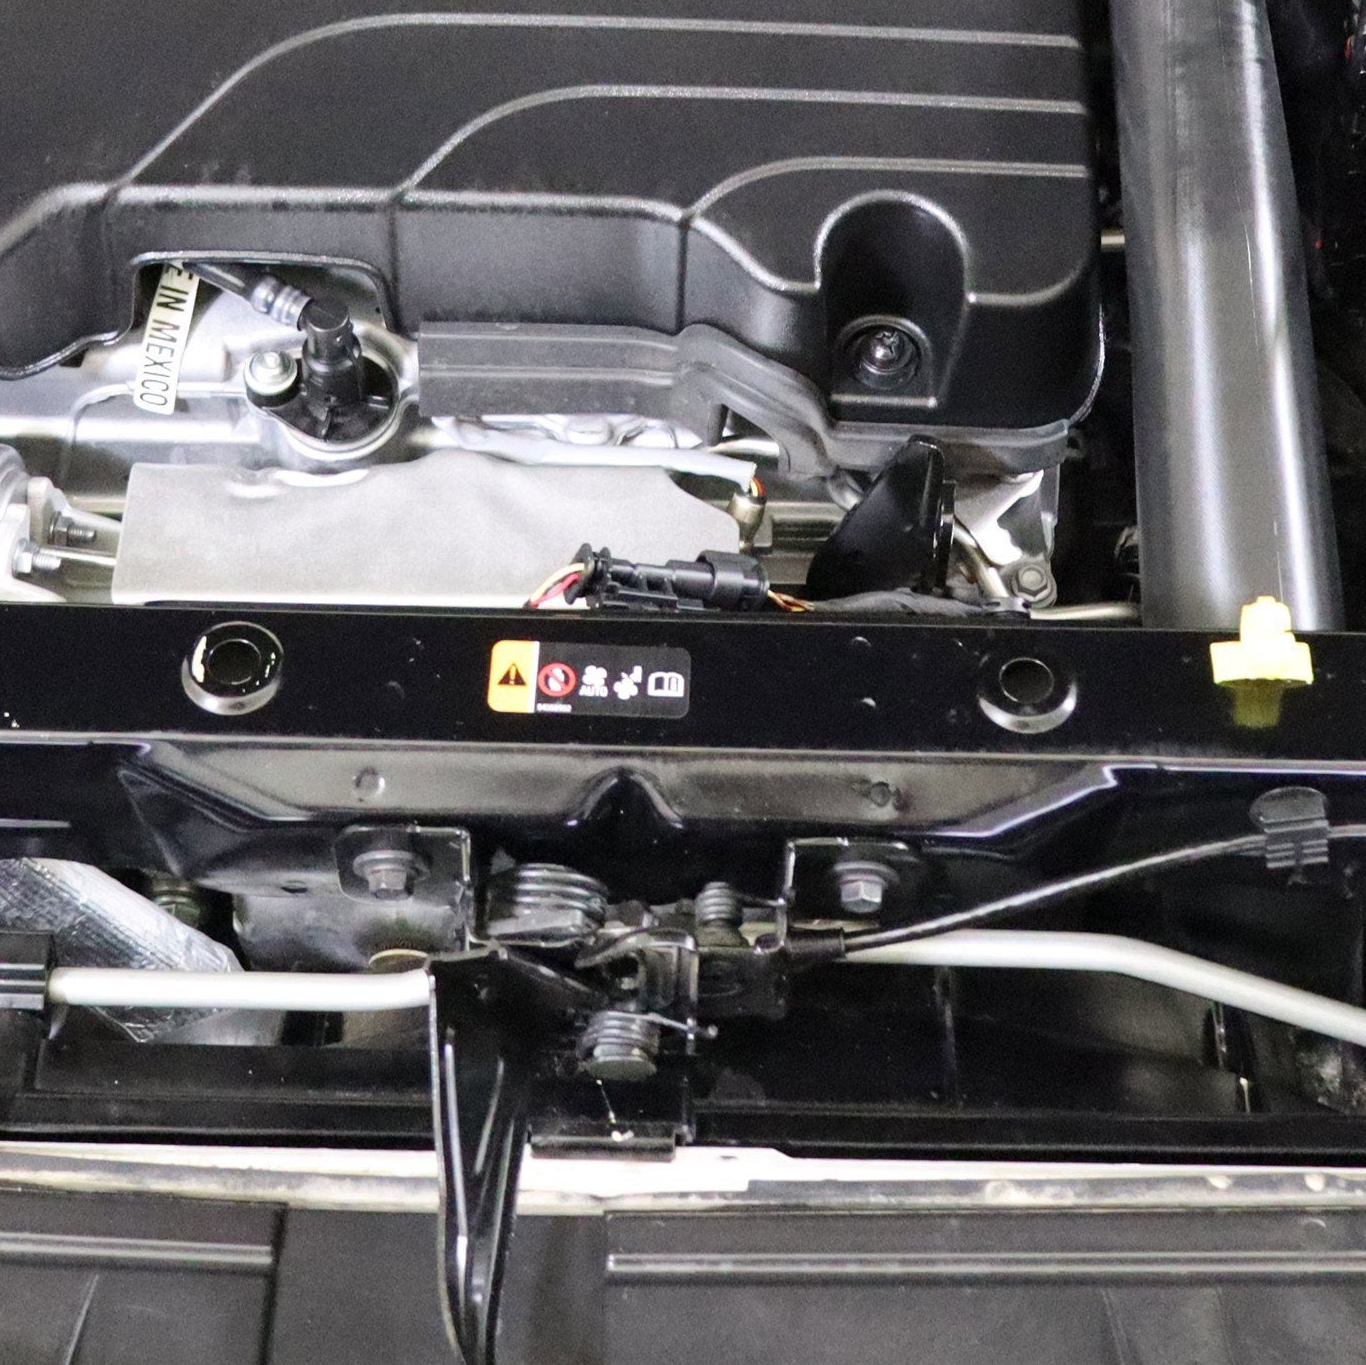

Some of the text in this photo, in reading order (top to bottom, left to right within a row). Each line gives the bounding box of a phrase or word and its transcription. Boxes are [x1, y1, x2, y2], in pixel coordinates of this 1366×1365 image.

[156, 285, 189, 312] IN
[139, 319, 181, 407] MEXICO
[579, 685, 608, 697] AUTO
